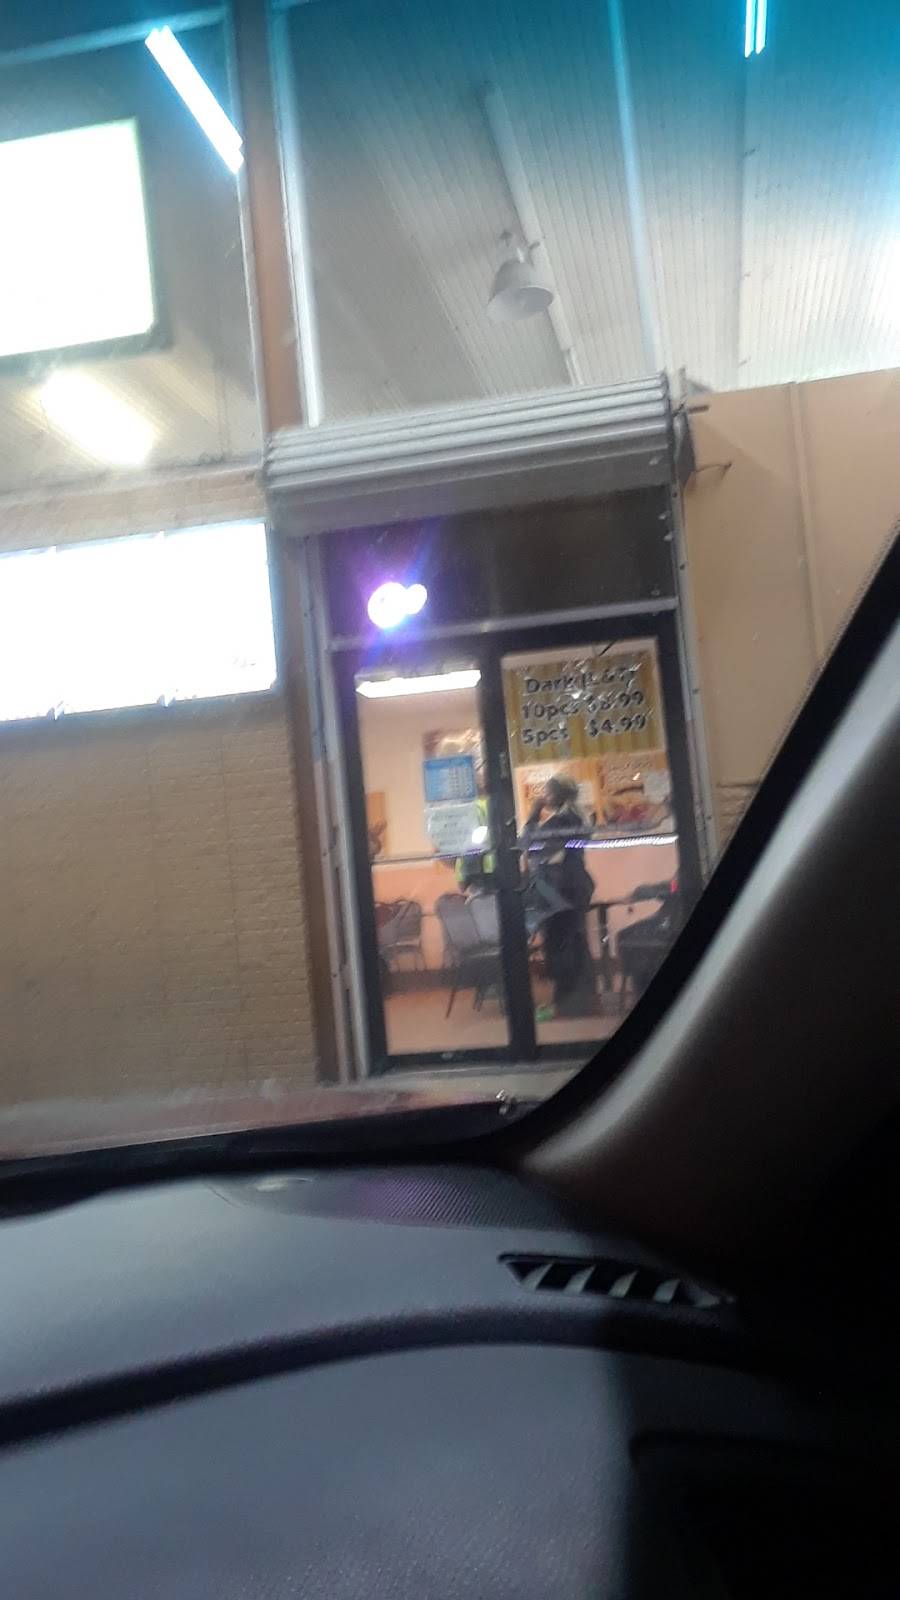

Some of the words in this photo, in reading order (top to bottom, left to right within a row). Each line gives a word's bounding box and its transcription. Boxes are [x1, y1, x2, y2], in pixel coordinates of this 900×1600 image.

[526, 674, 573, 693] Dark
[522, 701, 579, 721] 10pcs
[522, 727, 569, 747] 5pcs
[589, 714, 646, 737] $4.99
